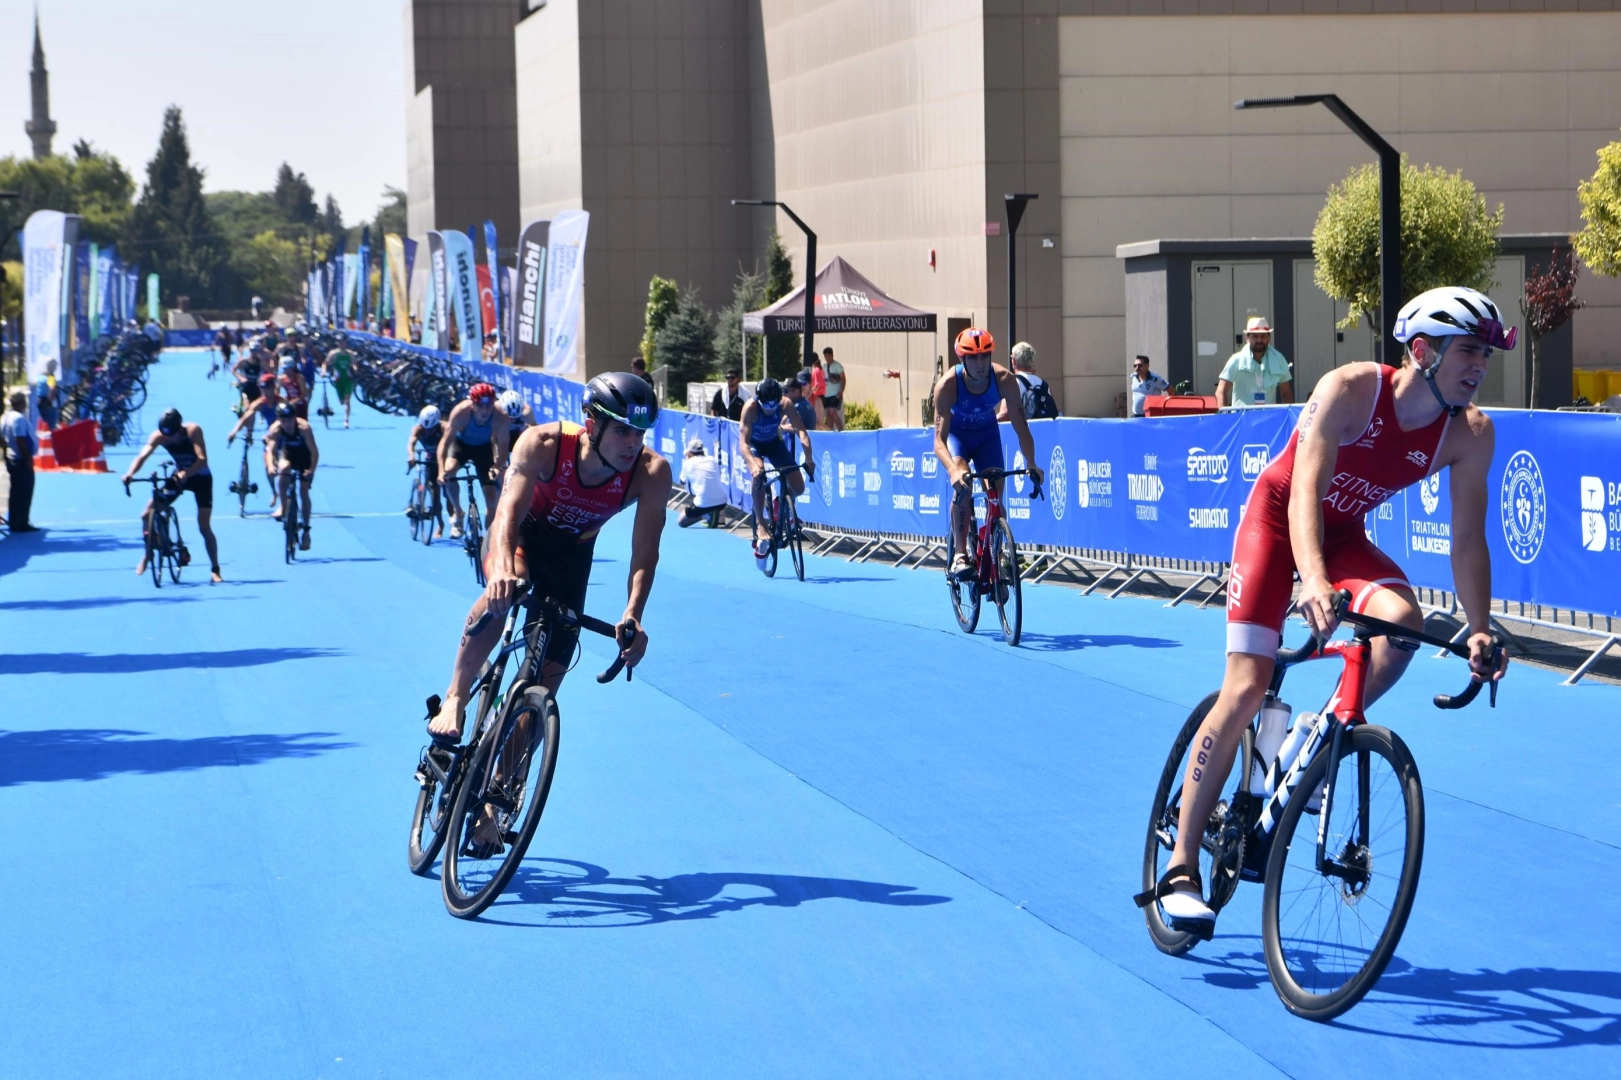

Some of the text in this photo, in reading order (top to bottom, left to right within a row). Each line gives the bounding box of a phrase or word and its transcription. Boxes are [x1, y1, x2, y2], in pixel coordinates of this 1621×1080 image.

[519, 240, 540, 344] Bianchi
[862, 317, 927, 330] FEDERASYONU
[1127, 474, 1158, 502] TRIATLON
[1323, 491, 1368, 516] AUT
[1378, 503, 1392, 520] 2023
[551, 506, 588, 525] ESP
[1189, 508, 1228, 528] SHIMANO
[1411, 520, 1450, 536] TRIATHLON
[1412, 536, 1450, 555] BALIKESIR
[1230, 563, 1243, 611] JOL
[1192, 736, 1213, 782] 069
[1318, 784, 1329, 845] TREK
